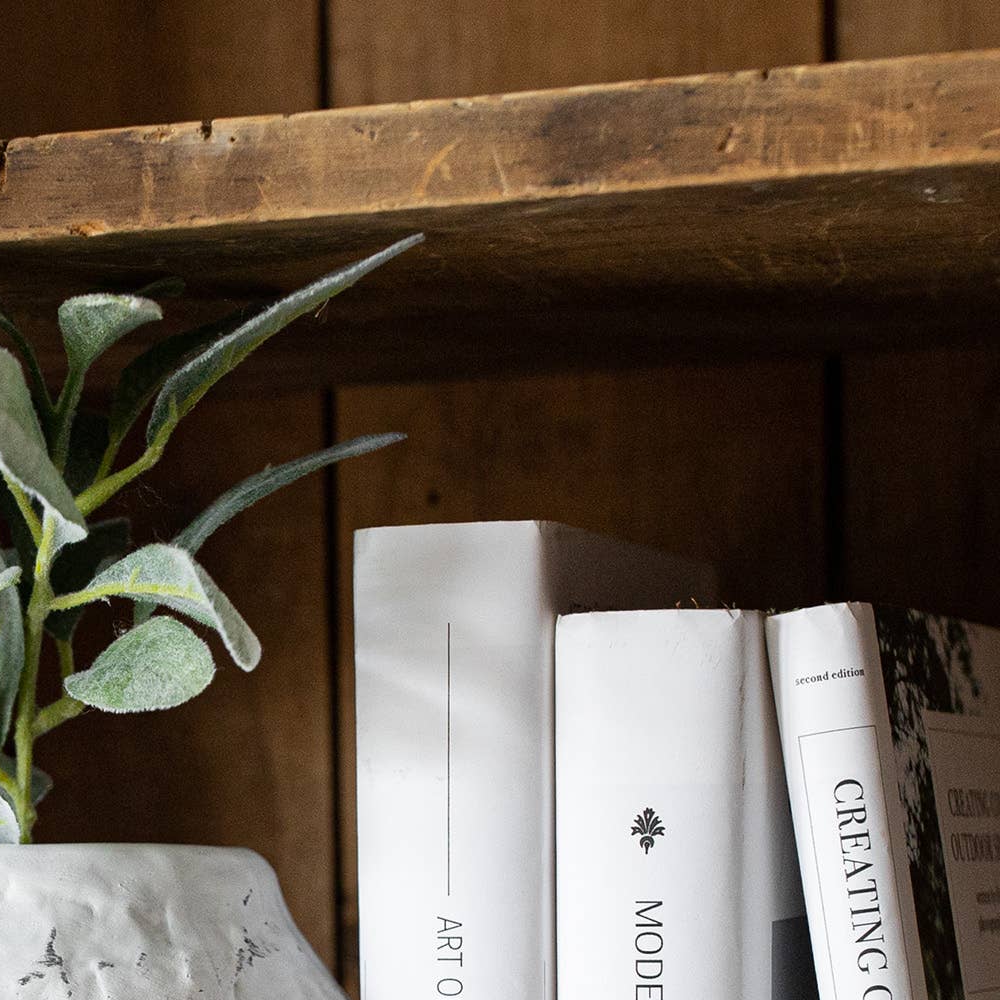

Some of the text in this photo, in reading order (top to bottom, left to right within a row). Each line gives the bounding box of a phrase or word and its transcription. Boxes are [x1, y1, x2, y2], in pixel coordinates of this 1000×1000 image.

[795, 667, 865, 686] second edition
[833, 779, 889, 975] CREATING
[436, 915, 463, 967] ART
